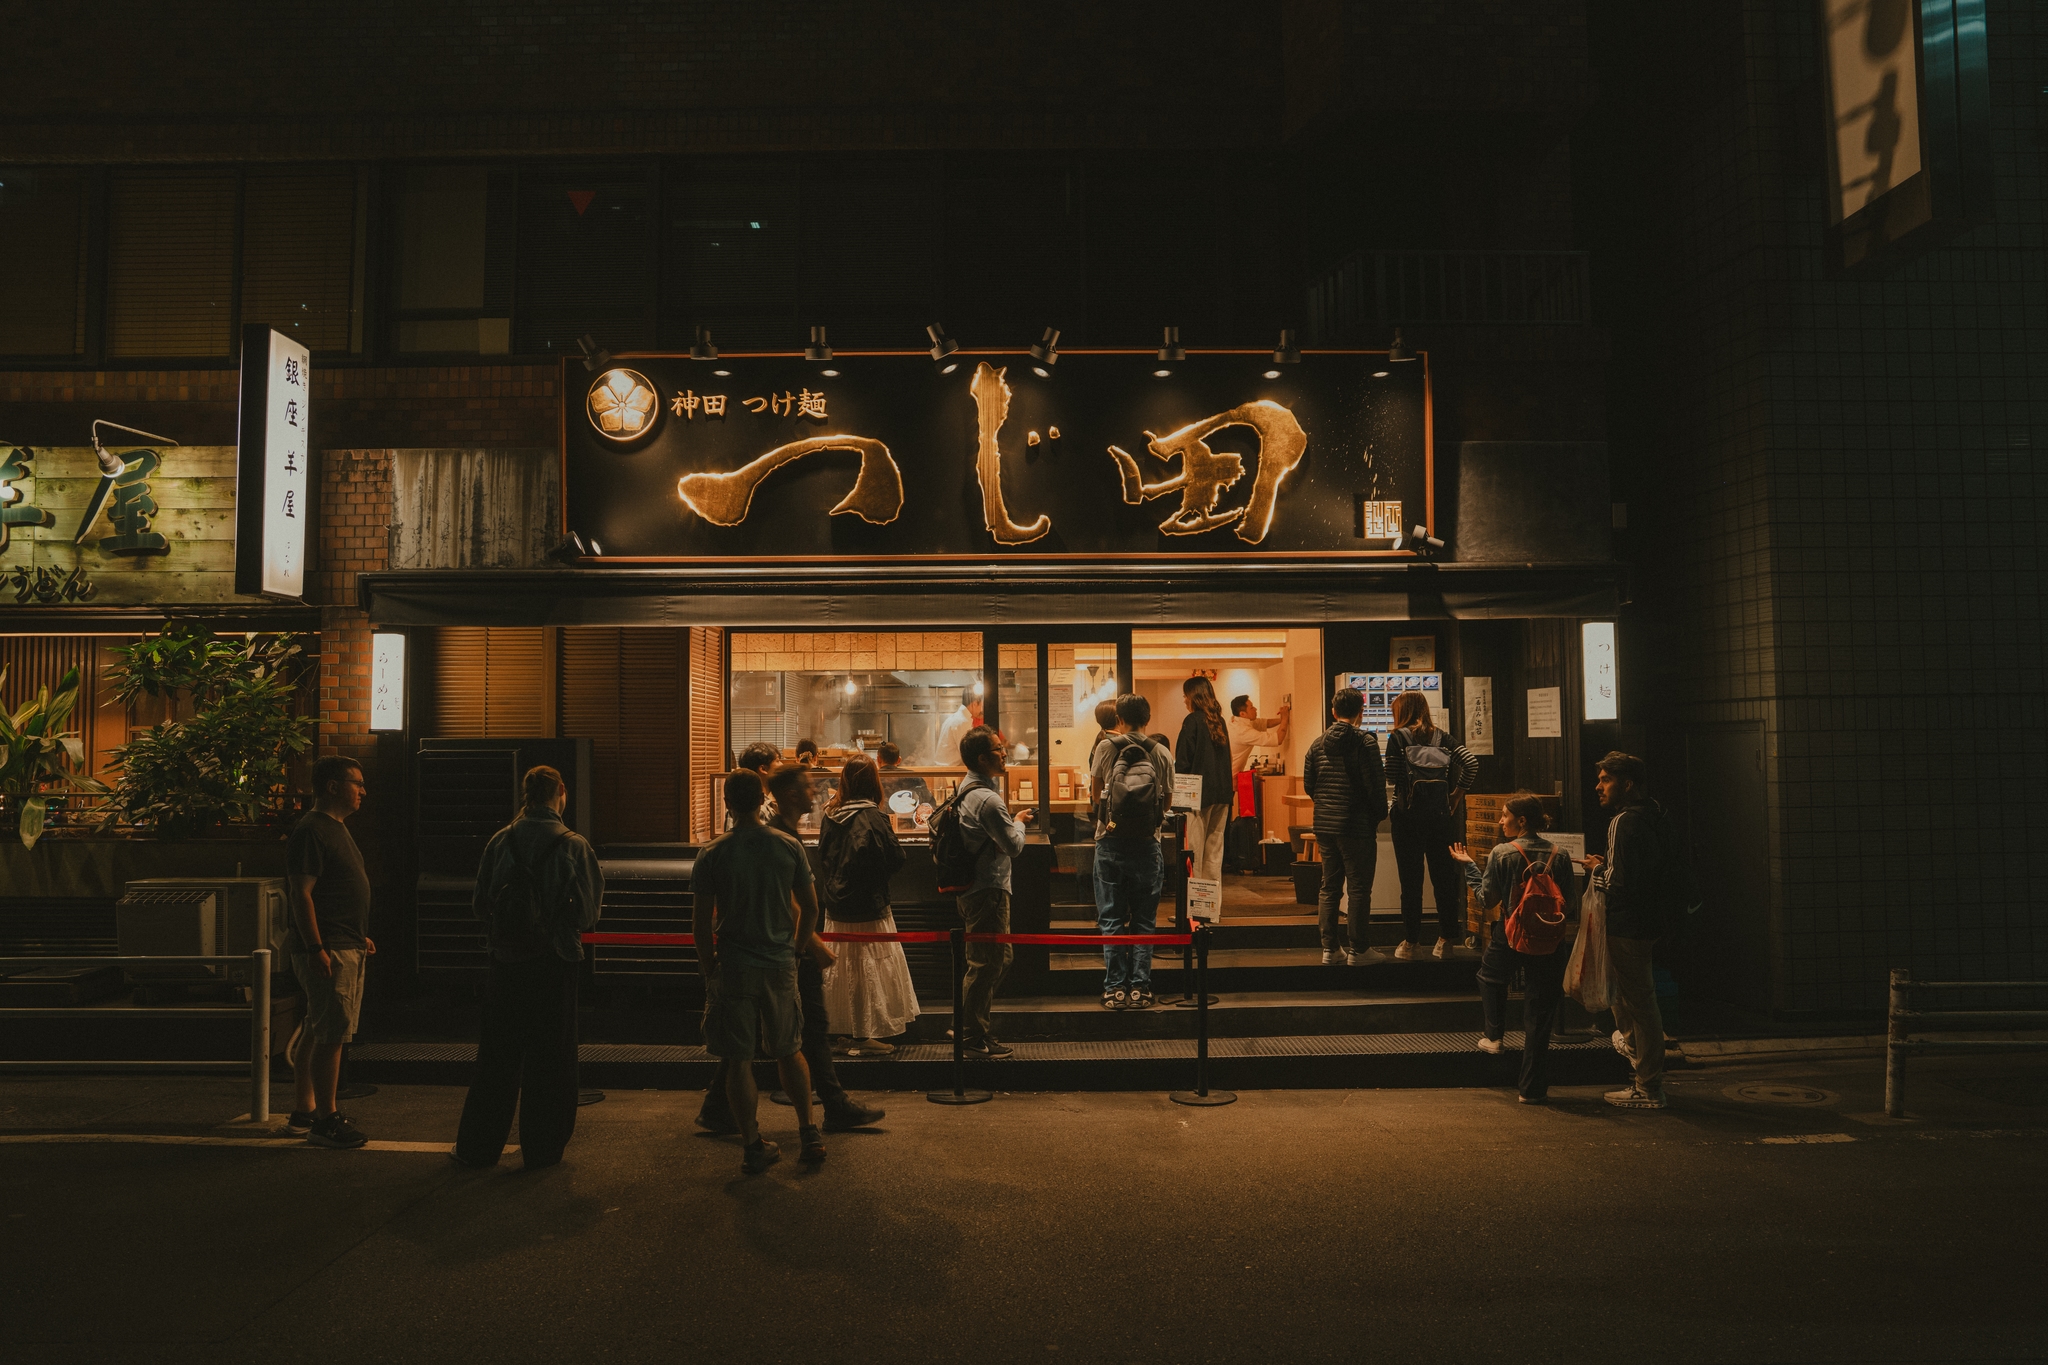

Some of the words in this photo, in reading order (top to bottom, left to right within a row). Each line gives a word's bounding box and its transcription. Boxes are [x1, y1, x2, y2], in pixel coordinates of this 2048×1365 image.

[282, 356, 300, 518] 銀座羊屋
[671, 388, 727, 419] 神田
[742, 388, 829, 419] つけ麺
[677, 362, 1307, 545] つじ田
[0, 564, 93, 601] うどん
